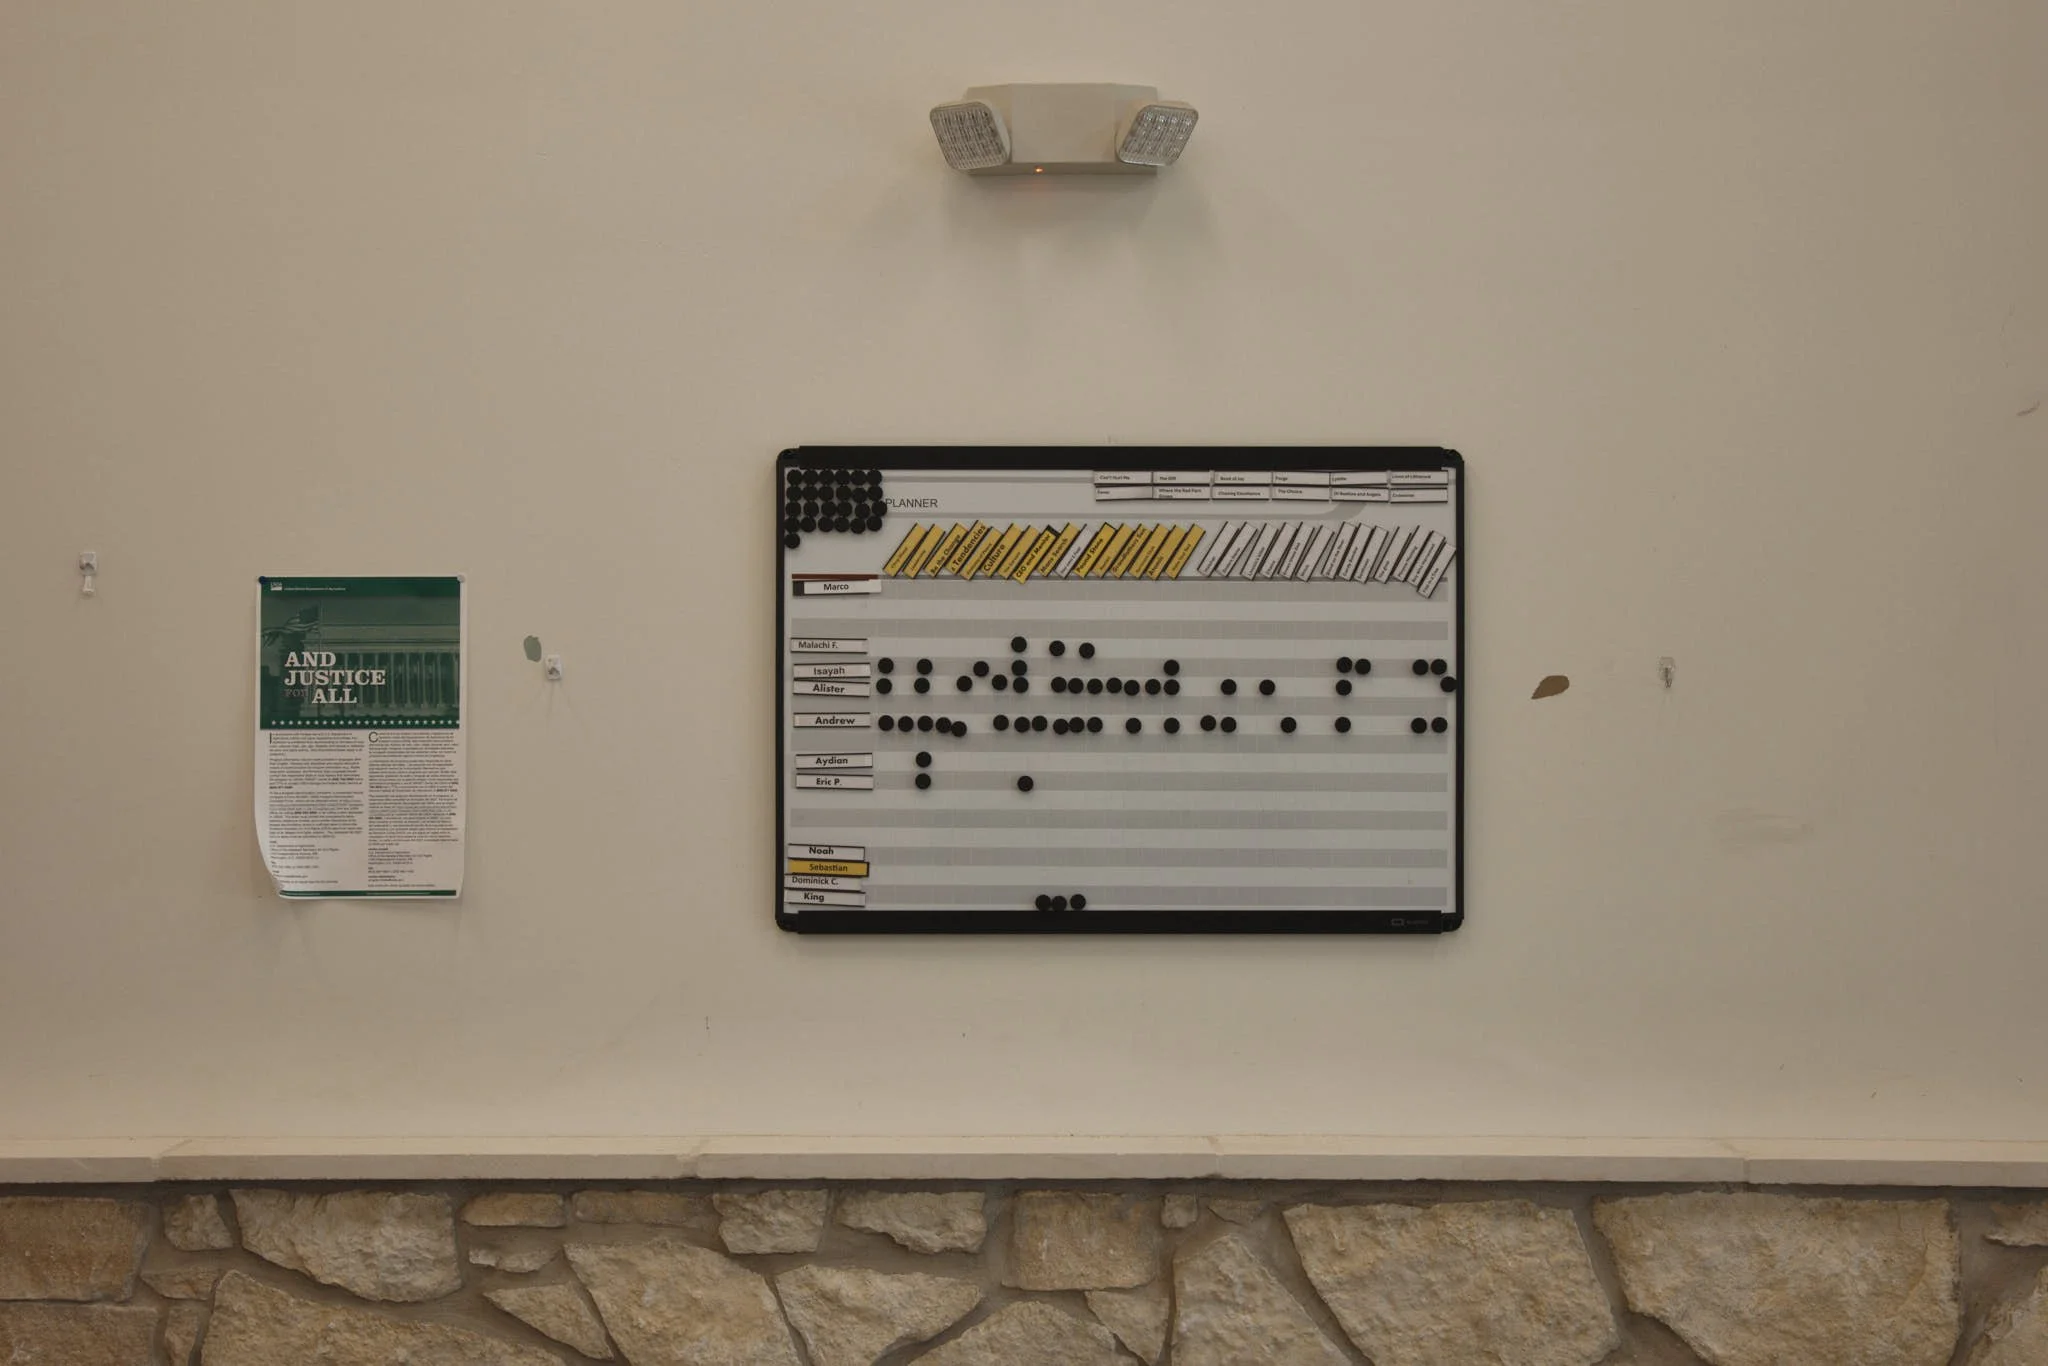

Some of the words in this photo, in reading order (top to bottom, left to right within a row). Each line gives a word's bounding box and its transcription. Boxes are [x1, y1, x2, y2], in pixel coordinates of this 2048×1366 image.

[885, 498, 938, 508] PLANNER
[952, 522, 986, 568] Tendencies
[982, 542, 1006, 572] Culture
[823, 582, 849, 591] Marco
[798, 640, 829, 649] Malachi
[831, 641, 838, 649] F.
[285, 651, 336, 667] AND
[813, 666, 846, 676] Isayah
[284, 669, 386, 686] JUSTICE
[812, 683, 845, 694] Alister
[312, 687, 358, 704] ALL
[815, 715, 855, 726] Andrew
[815, 756, 848, 766] Aydian
[816, 777, 831, 787] Eric
[833, 778, 842, 786] P.
[808, 846, 834, 855] Noah
[808, 863, 848, 872] Sebastian
[791, 876, 829, 885] Dominick
[804, 892, 824, 903] King
